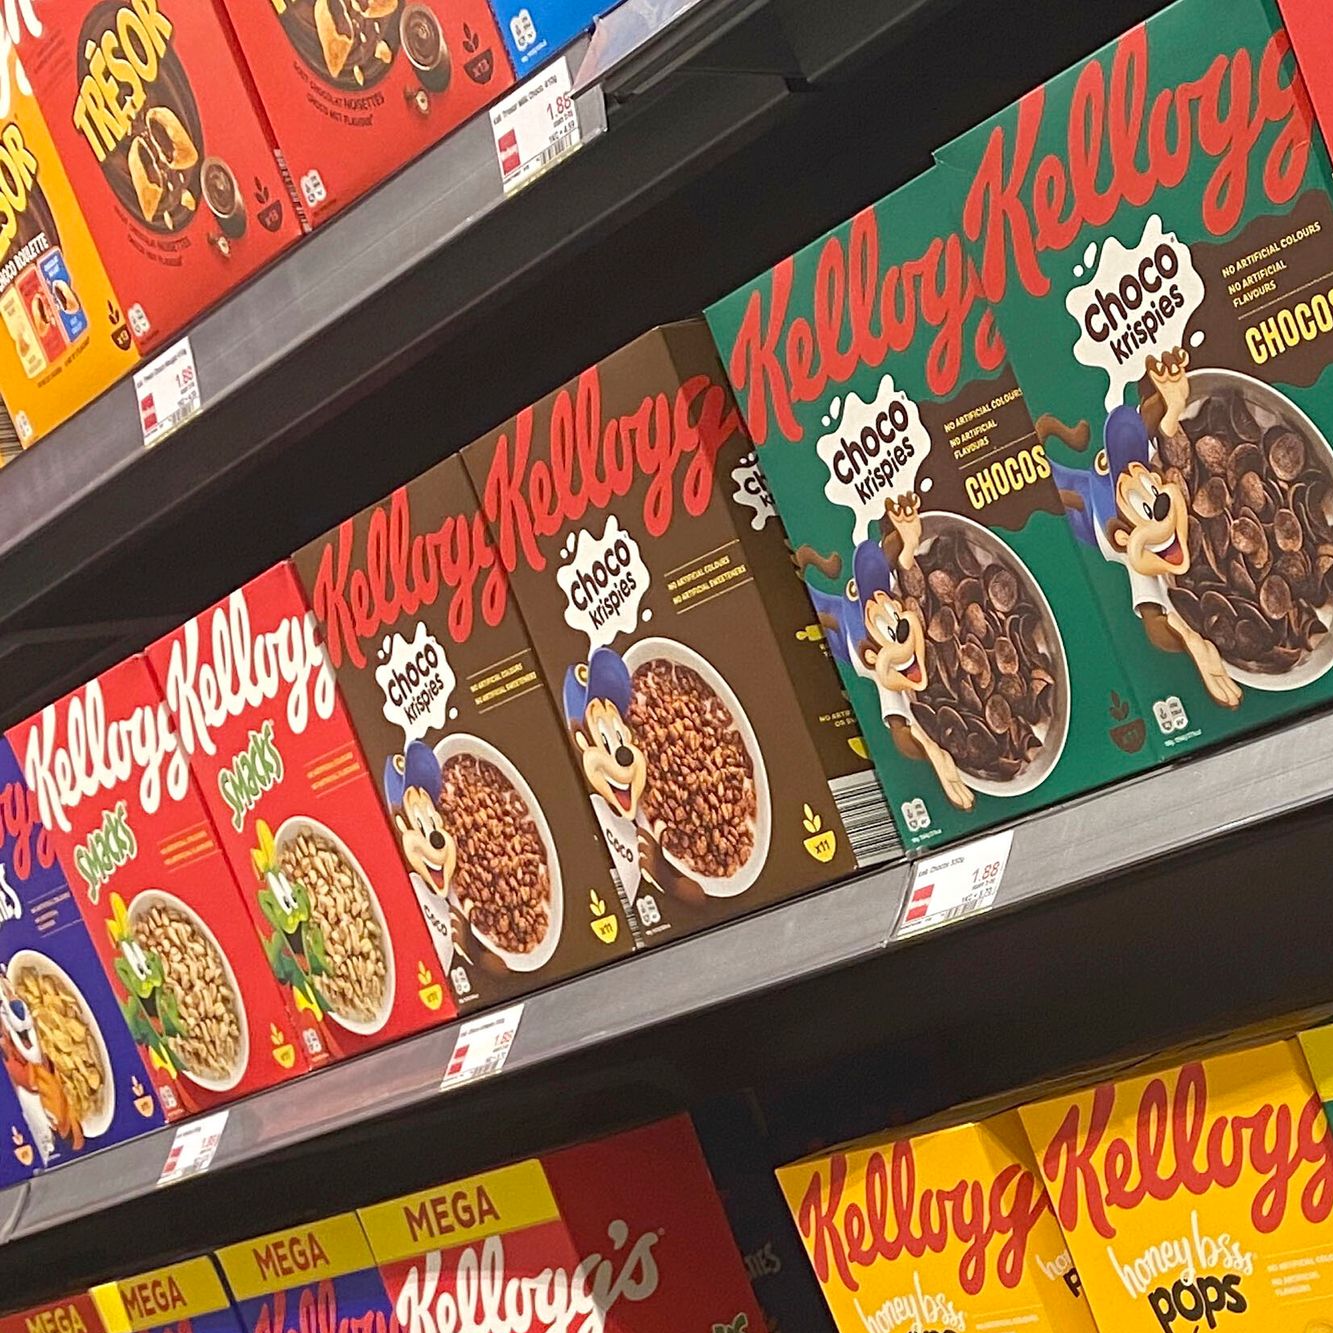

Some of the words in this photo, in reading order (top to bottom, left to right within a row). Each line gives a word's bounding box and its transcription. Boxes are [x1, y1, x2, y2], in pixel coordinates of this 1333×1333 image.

[1084, 240, 1180, 345] choco
[1232, 280, 1277, 308] FLAVOURS
[1109, 284, 1185, 366] krispies
[833, 399, 909, 487] choco
[855, 435, 916, 507] krispies
[965, 445, 1051, 509] CHOCOS
[570, 538, 631, 611] choco
[588, 572, 638, 631] krispies
[388, 643, 438, 707] choco
[402, 1184, 501, 1242] MEGA
[252, 1232, 331, 1281] MEGA
[123, 1276, 188, 1321] MEGA
